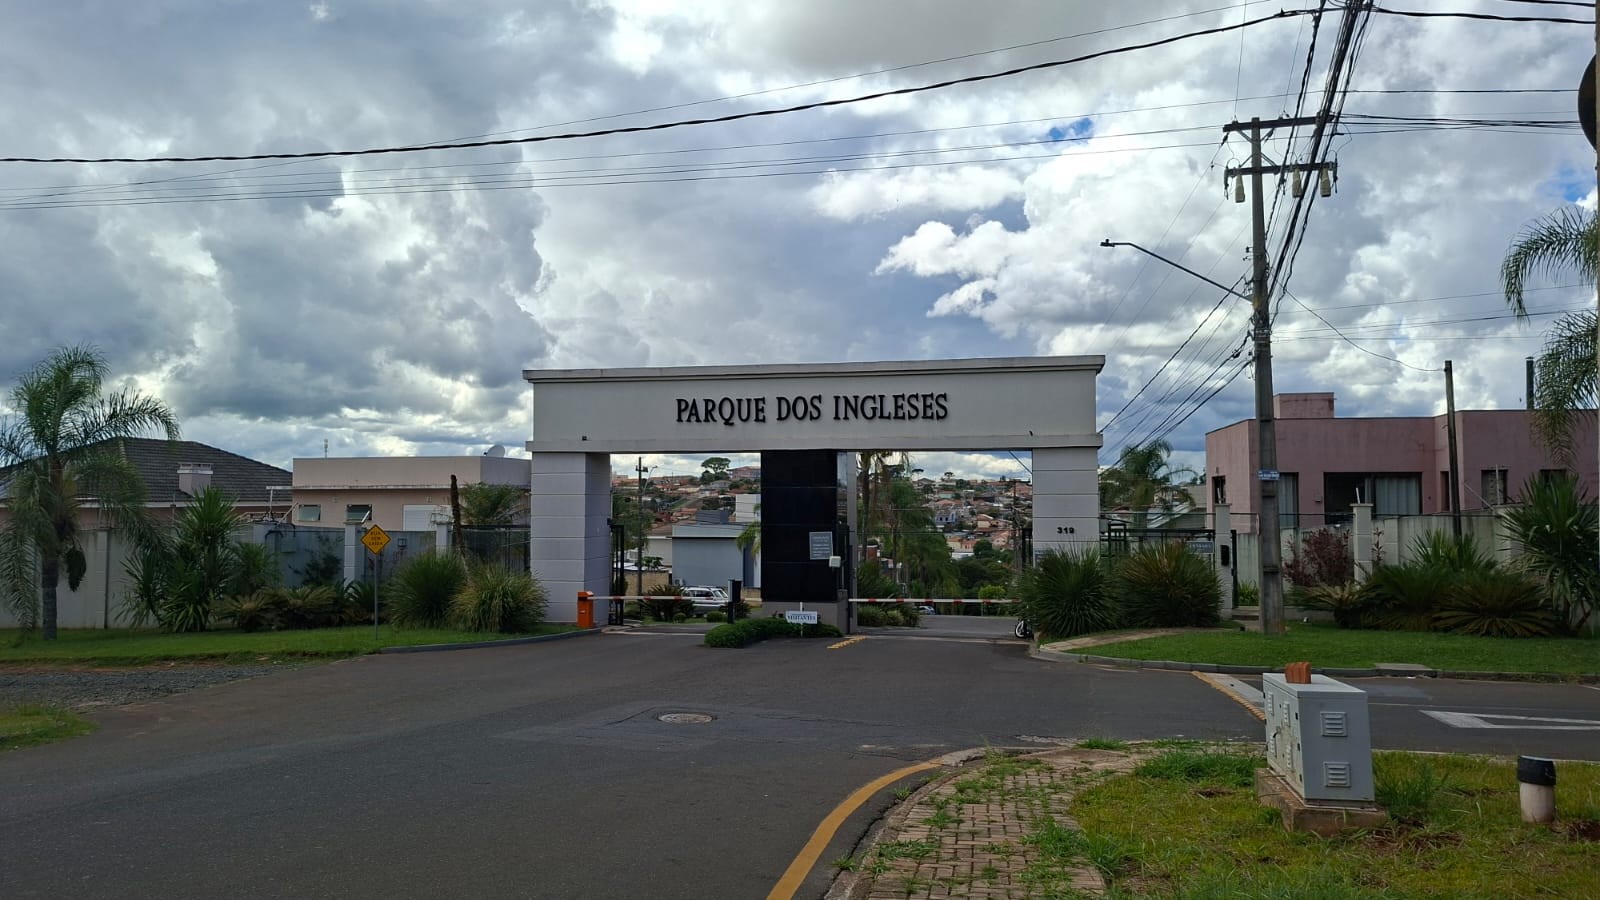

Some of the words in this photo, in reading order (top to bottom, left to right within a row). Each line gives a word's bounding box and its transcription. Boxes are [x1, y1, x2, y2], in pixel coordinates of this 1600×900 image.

[676, 397, 766, 426] PARQUE
[776, 394, 822, 421] DOS
[833, 392, 948, 420] INGLESES
